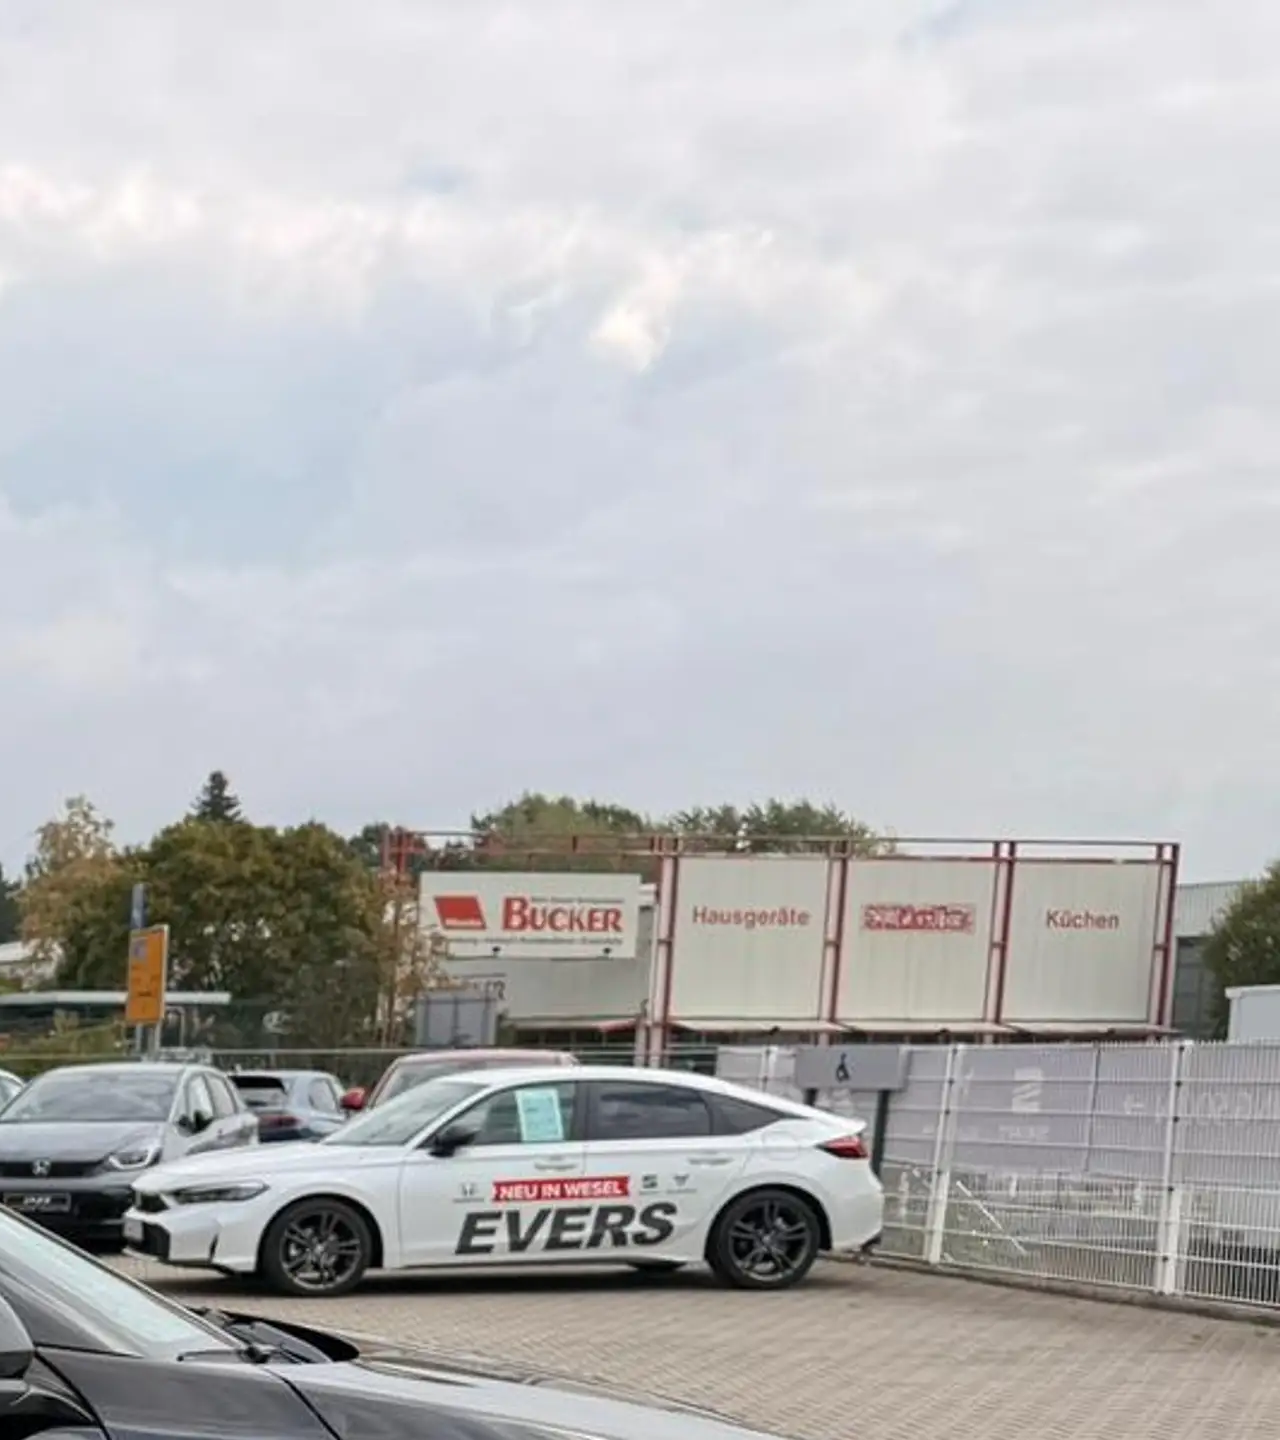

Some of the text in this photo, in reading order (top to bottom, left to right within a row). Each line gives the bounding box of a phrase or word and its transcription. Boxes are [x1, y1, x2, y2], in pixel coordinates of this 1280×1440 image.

[691, 905, 812, 929] Hausgeräte
[1045, 909, 1120, 930] Küchen
[499, 1179, 624, 1200] NEU IN WESEL
[454, 1201, 678, 1255] EVERS
